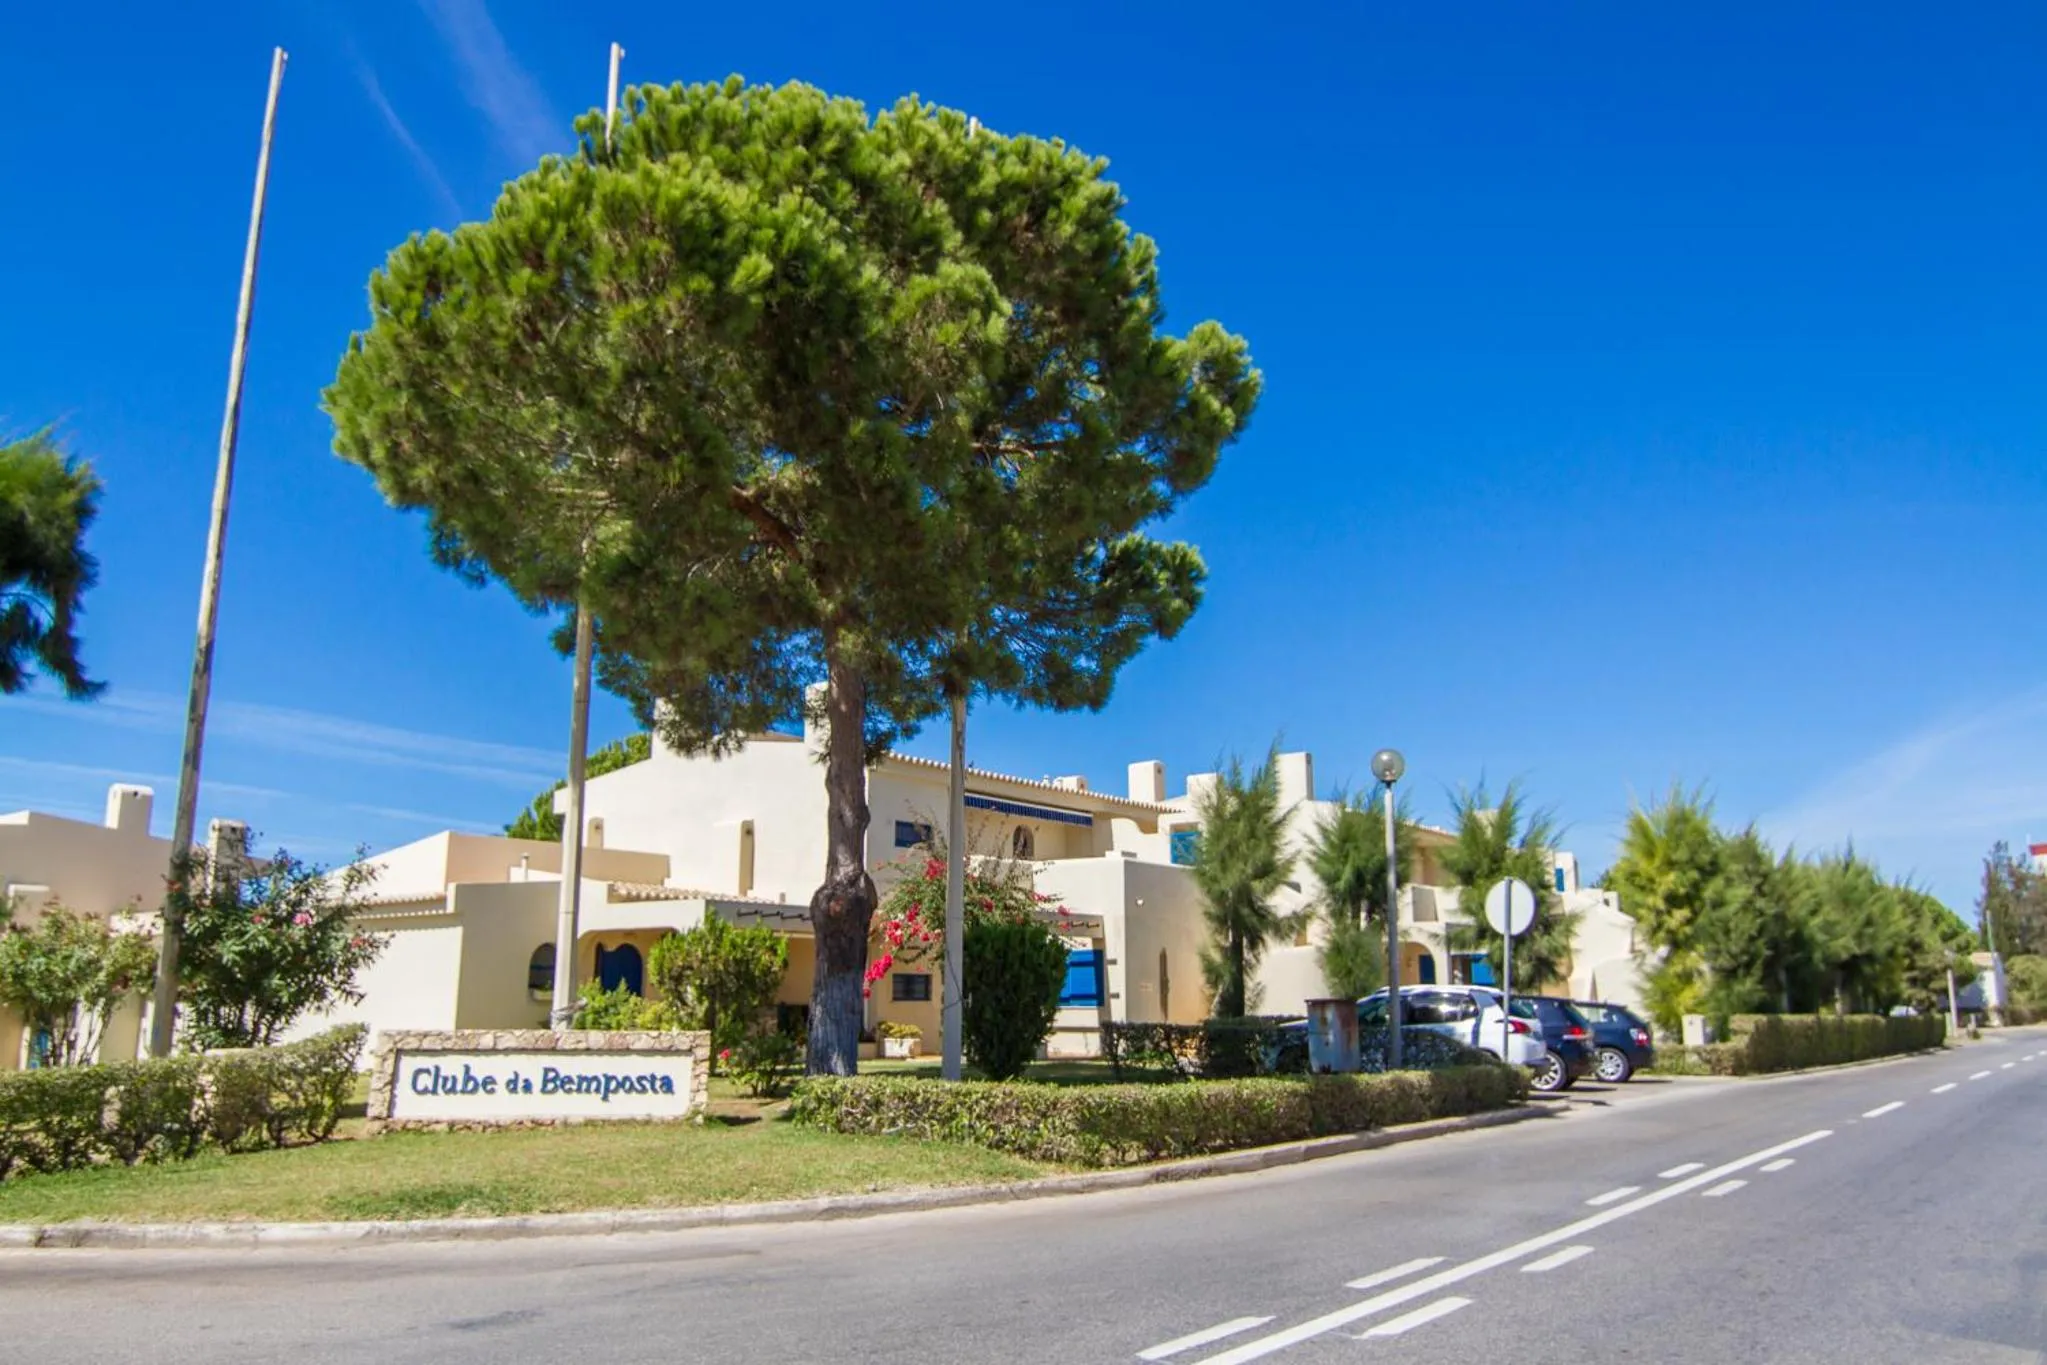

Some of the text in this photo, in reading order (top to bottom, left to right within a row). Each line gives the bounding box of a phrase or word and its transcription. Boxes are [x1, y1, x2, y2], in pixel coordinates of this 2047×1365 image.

[411, 1064, 674, 1101] Clube da Bemposta
